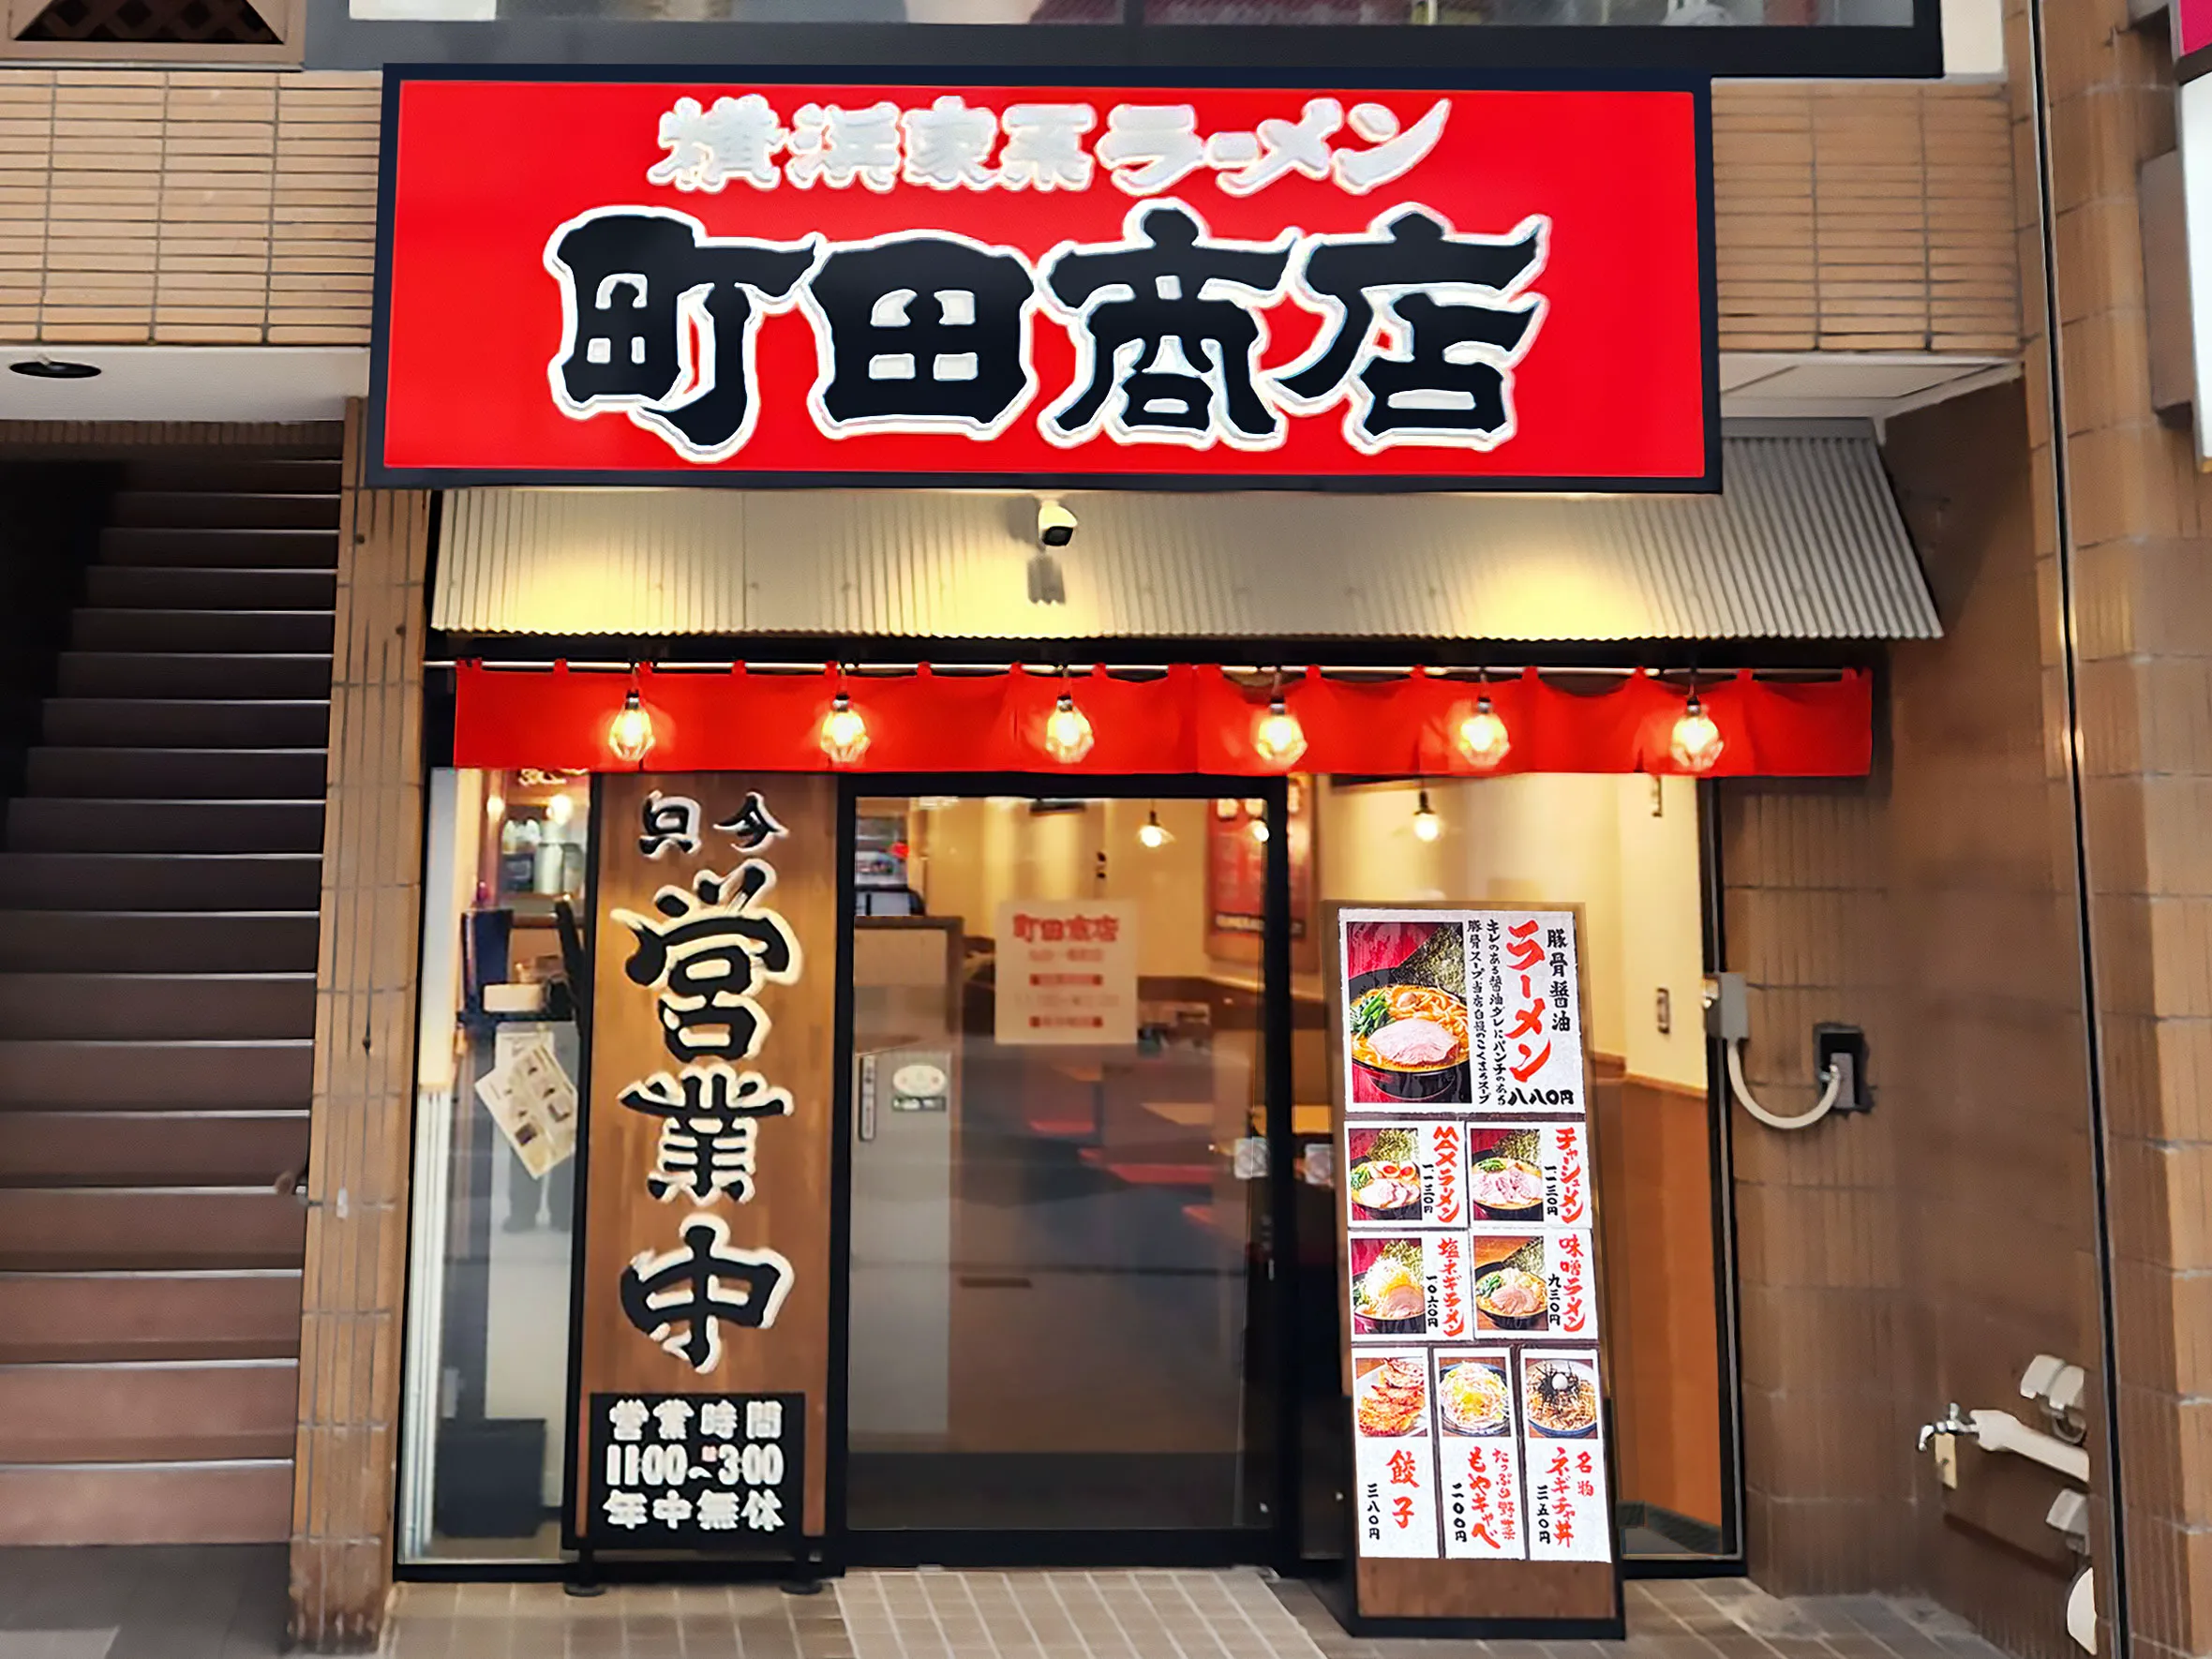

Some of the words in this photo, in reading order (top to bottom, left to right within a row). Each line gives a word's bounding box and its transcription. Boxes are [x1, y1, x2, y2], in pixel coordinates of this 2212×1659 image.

[543, 197, 1551, 463] 町田商店
[1504, 919, 1552, 1083] ラーメン
[1547, 928, 1571, 1032] 豚骨醤油
[610, 858, 803, 1374] 営業中
[1433, 1126, 1460, 1223] MAXラーメン
[1555, 1127, 1584, 1224] チャーシューメン
[1438, 1237, 1464, 1338] 塩ネギラーメン
[1559, 1233, 1586, 1332] 味噌ラーメン
[603, 1488, 785, 1532] 年中無休
[1385, 1448, 1420, 1530] 餃子
[1468, 1446, 1502, 1549] もやキャベ
[1492, 1448, 1516, 1540] たっぷり野菜
[1545, 1446, 1576, 1548] ネギチャ丼
[1575, 1451, 1594, 1497] 名物
